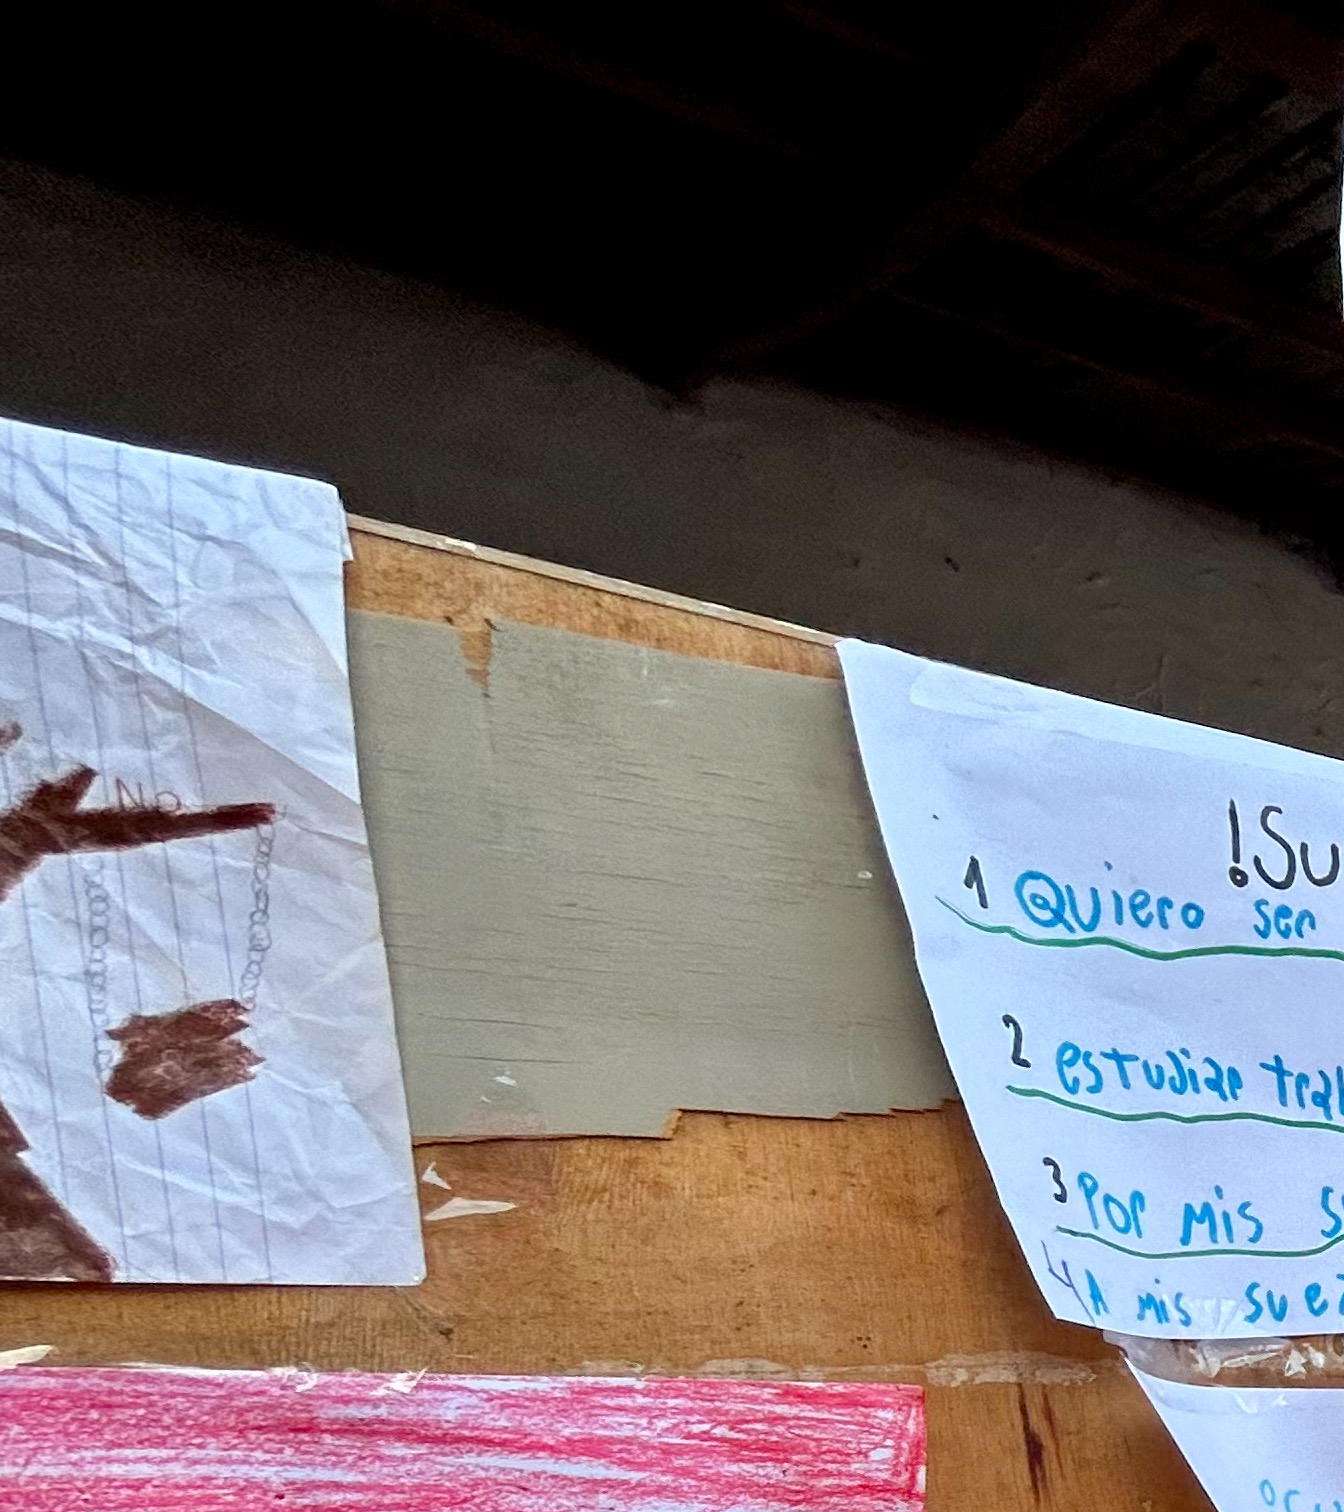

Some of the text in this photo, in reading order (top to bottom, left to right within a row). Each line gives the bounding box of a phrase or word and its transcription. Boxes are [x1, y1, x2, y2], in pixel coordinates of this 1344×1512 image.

[963, 855, 989, 909] 1
[1252, 897, 1317, 940] ser
[1003, 1014, 1032, 1068] 2
[1056, 1041, 1243, 1101] estudiar
[1043, 1157, 1069, 1203] 3
[1136, 1278, 1193, 1327] mis
